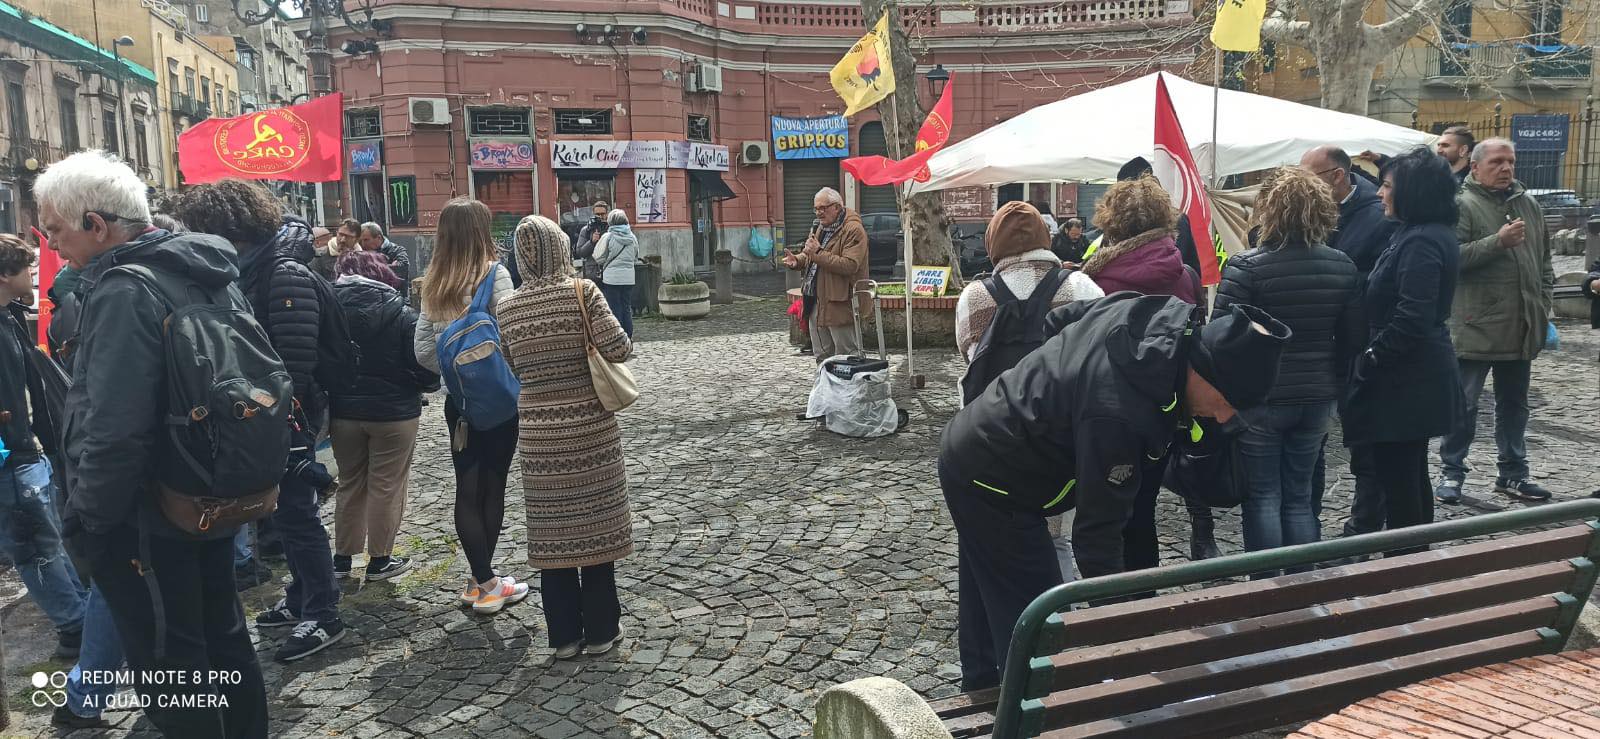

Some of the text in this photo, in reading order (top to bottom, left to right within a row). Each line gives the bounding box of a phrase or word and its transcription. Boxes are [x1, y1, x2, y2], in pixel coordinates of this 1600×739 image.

[775, 117, 846, 131] NUOVA APERTURA
[776, 133, 845, 151] GRIPPOS
[553, 143, 595, 167] Karol
[695, 146, 716, 168] Karol
[637, 173, 663, 189] Karol
[914, 277, 943, 285] LIBERO
[917, 270, 944, 278] MARE
